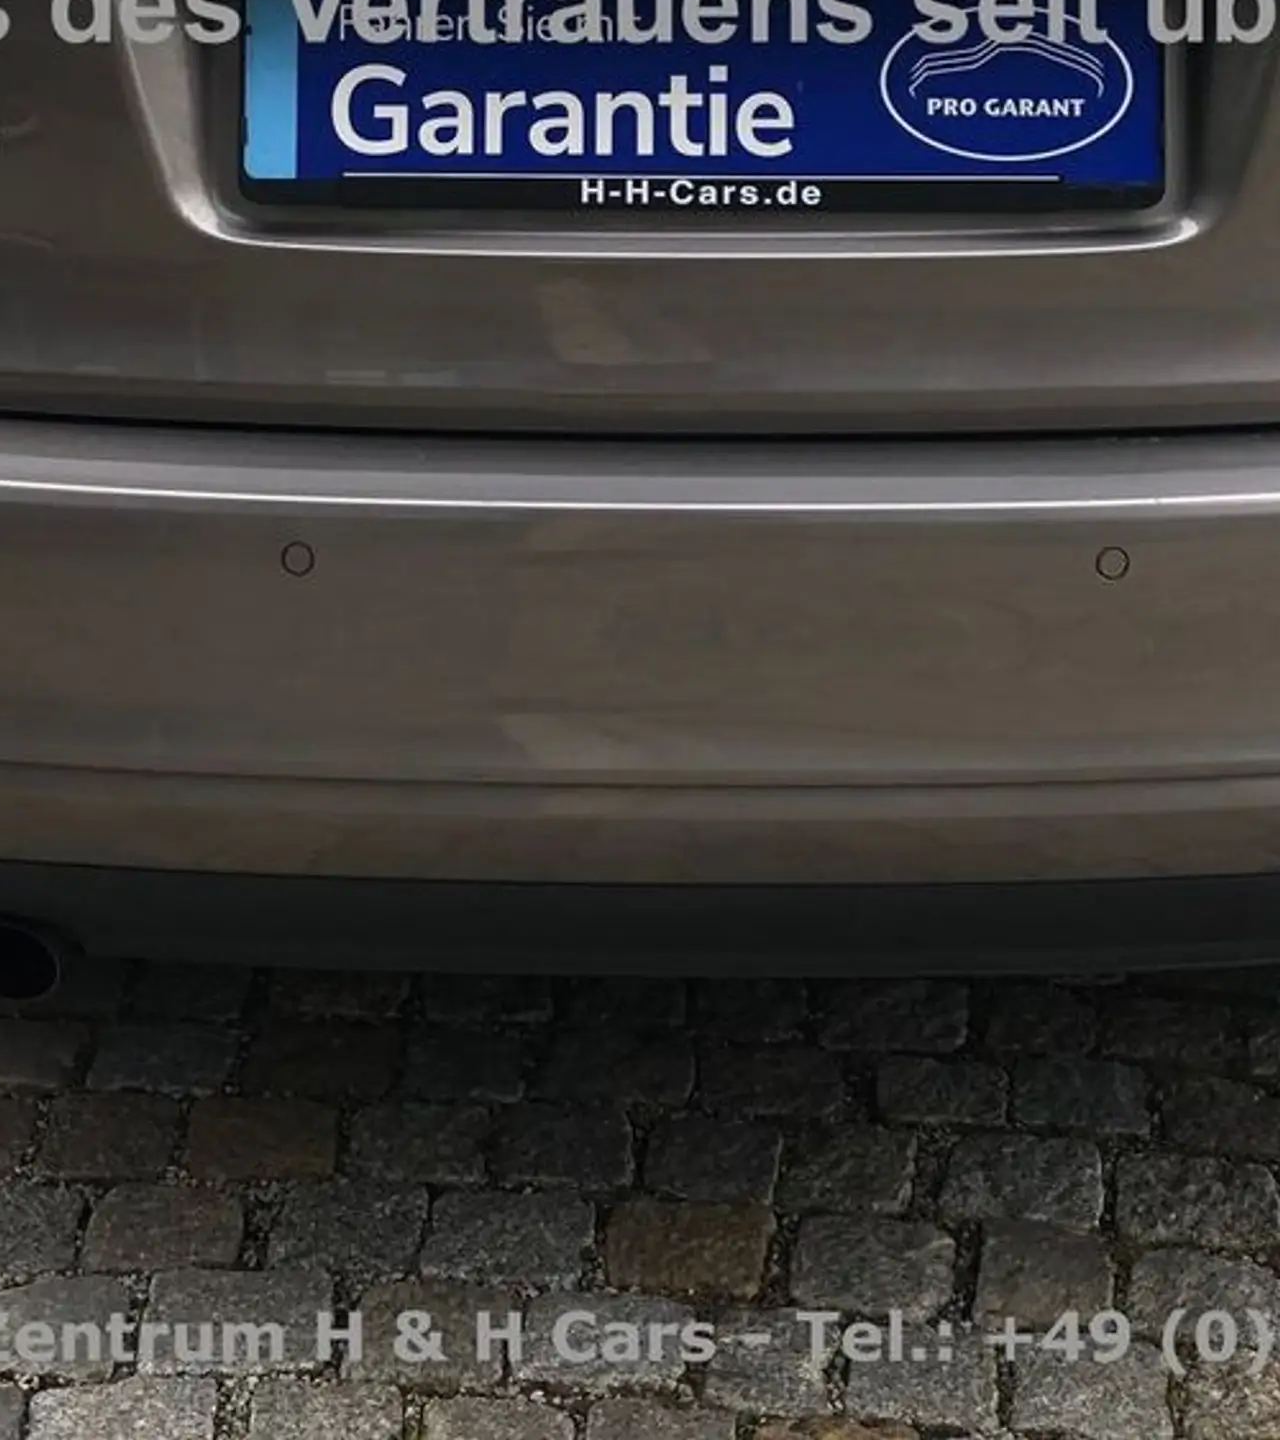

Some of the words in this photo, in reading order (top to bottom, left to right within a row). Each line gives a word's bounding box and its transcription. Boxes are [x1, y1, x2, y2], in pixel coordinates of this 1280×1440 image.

[331, 64, 795, 157] Garantie
[926, 97, 977, 117] PRO
[983, 97, 1086, 117] GARANT
[580, 178, 822, 206] H-H-Cars.de
